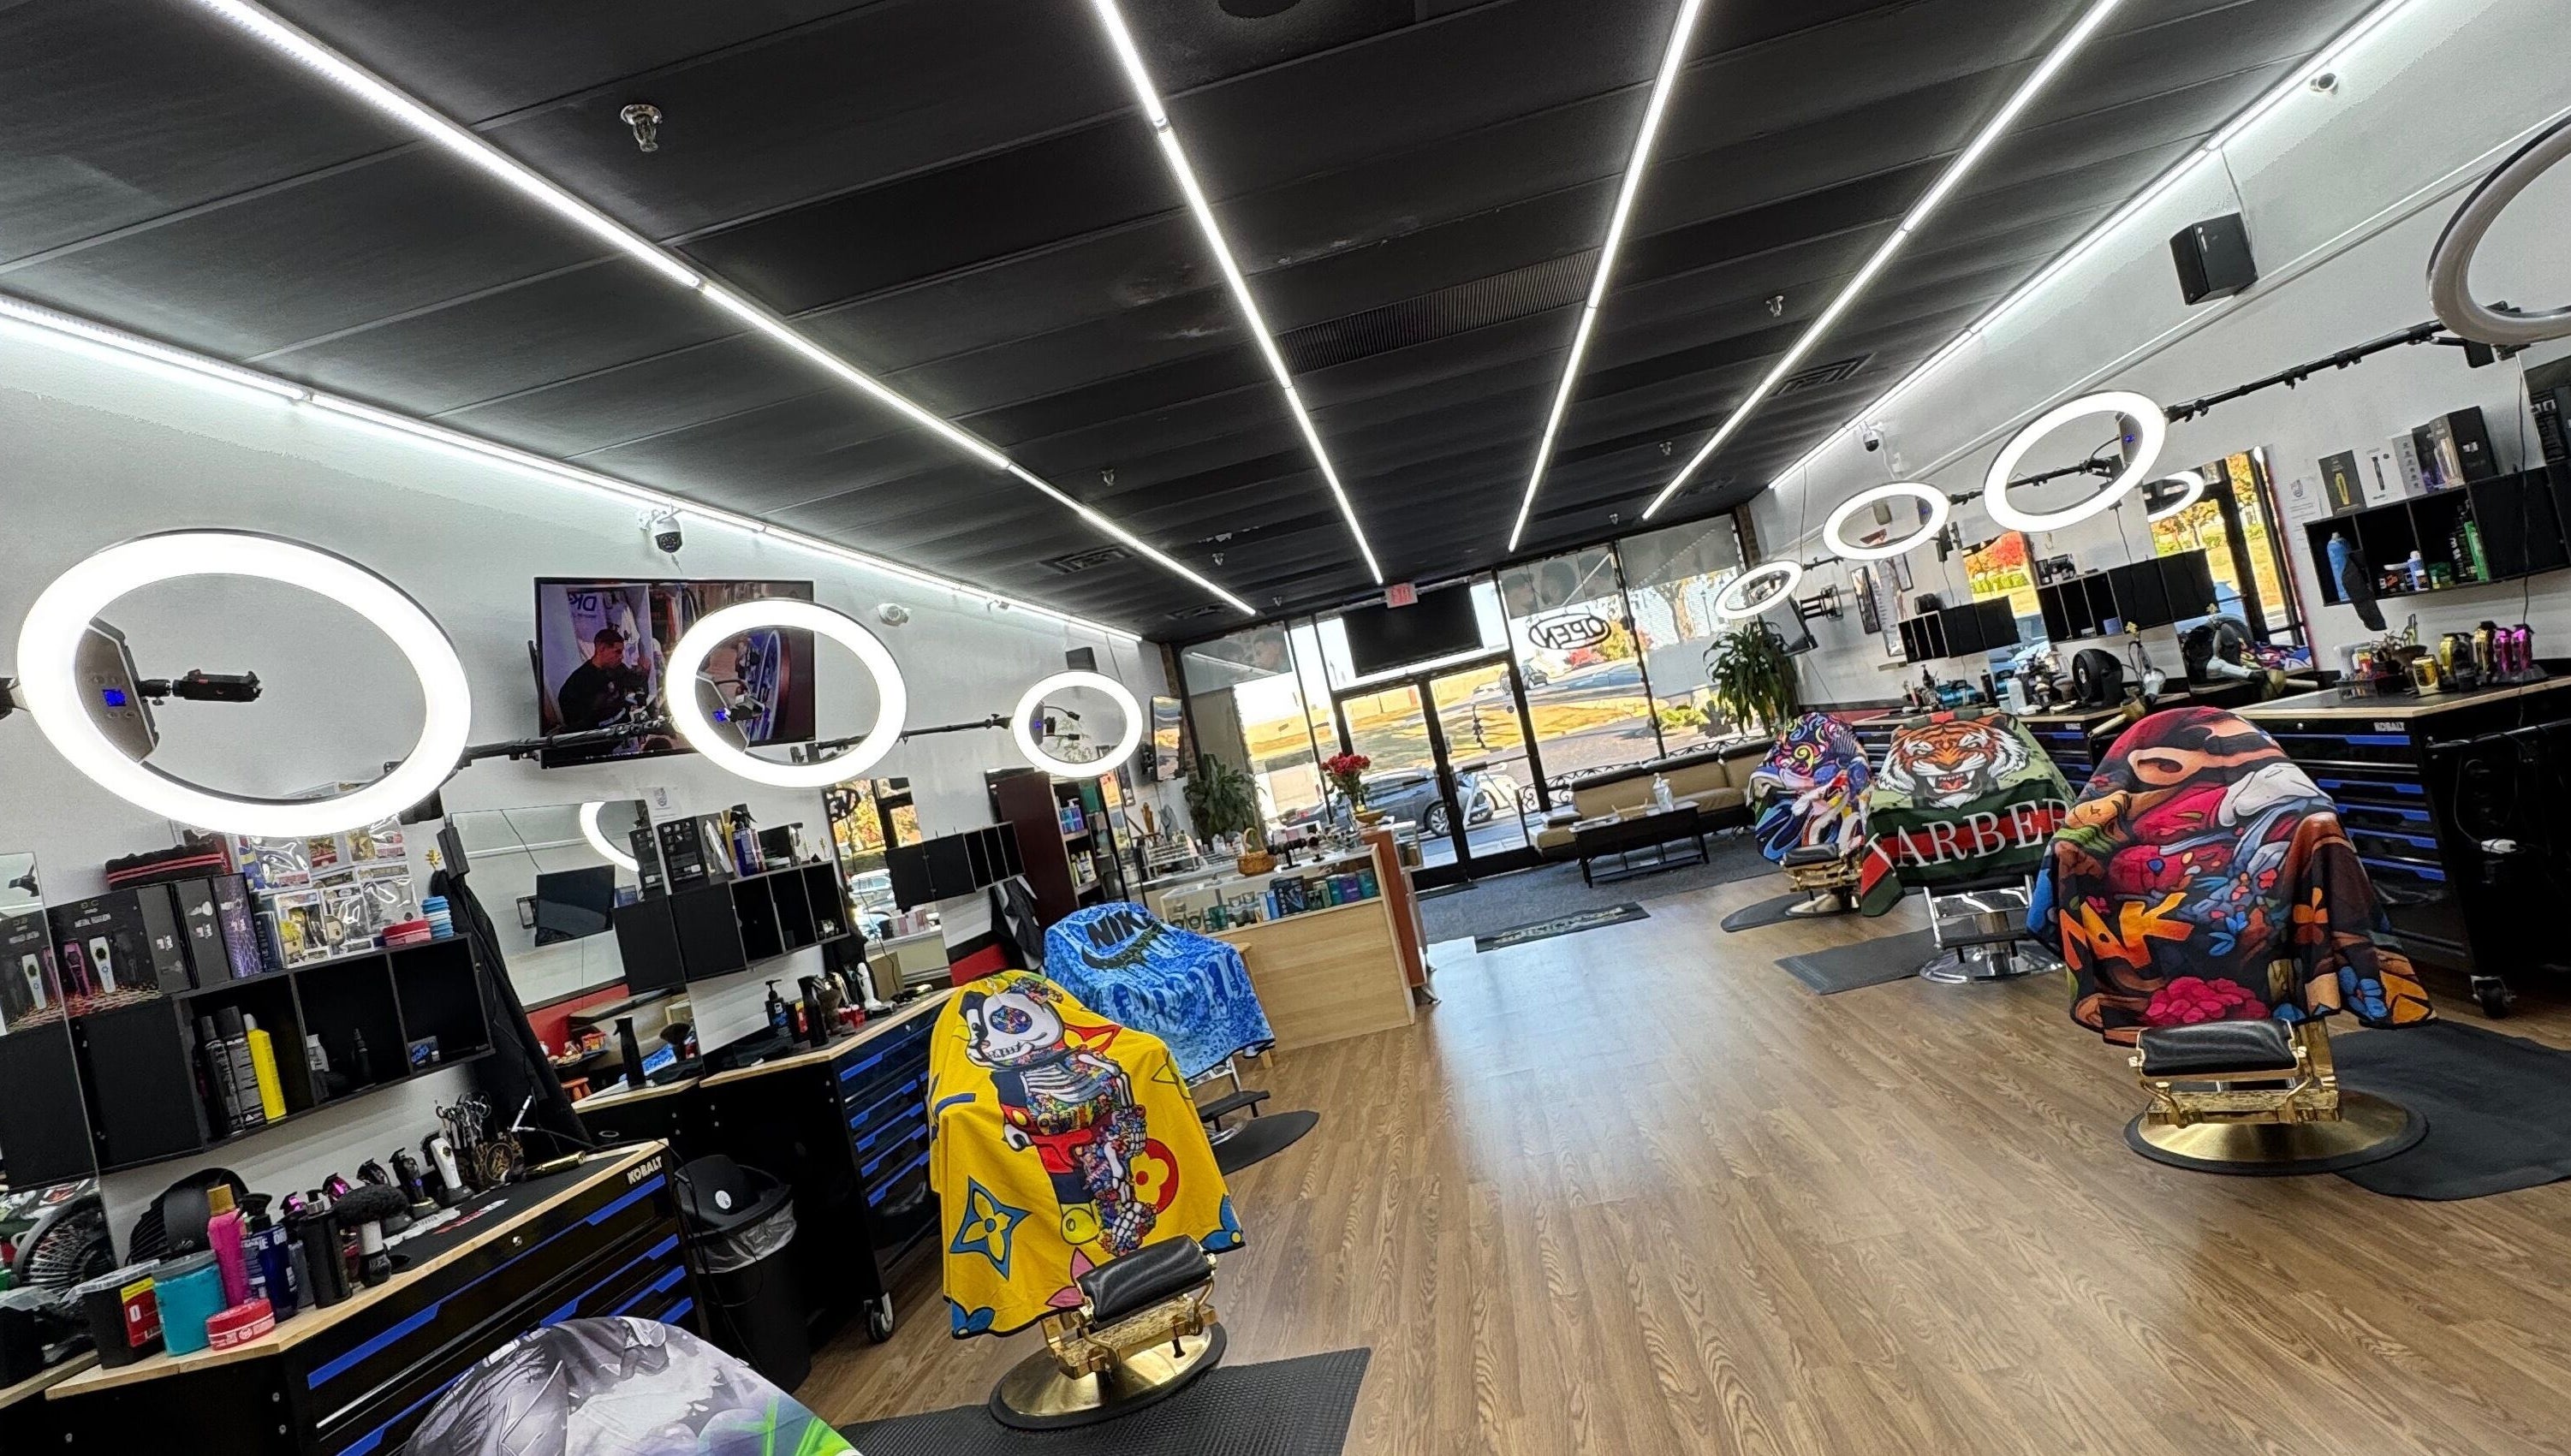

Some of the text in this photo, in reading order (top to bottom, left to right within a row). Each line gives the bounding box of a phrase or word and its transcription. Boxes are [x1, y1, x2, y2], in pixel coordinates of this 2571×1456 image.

[1866, 798, 2070, 877] ARBER
[1085, 910, 1155, 950] NIK
[627, 1156, 663, 1186] KOBALT
